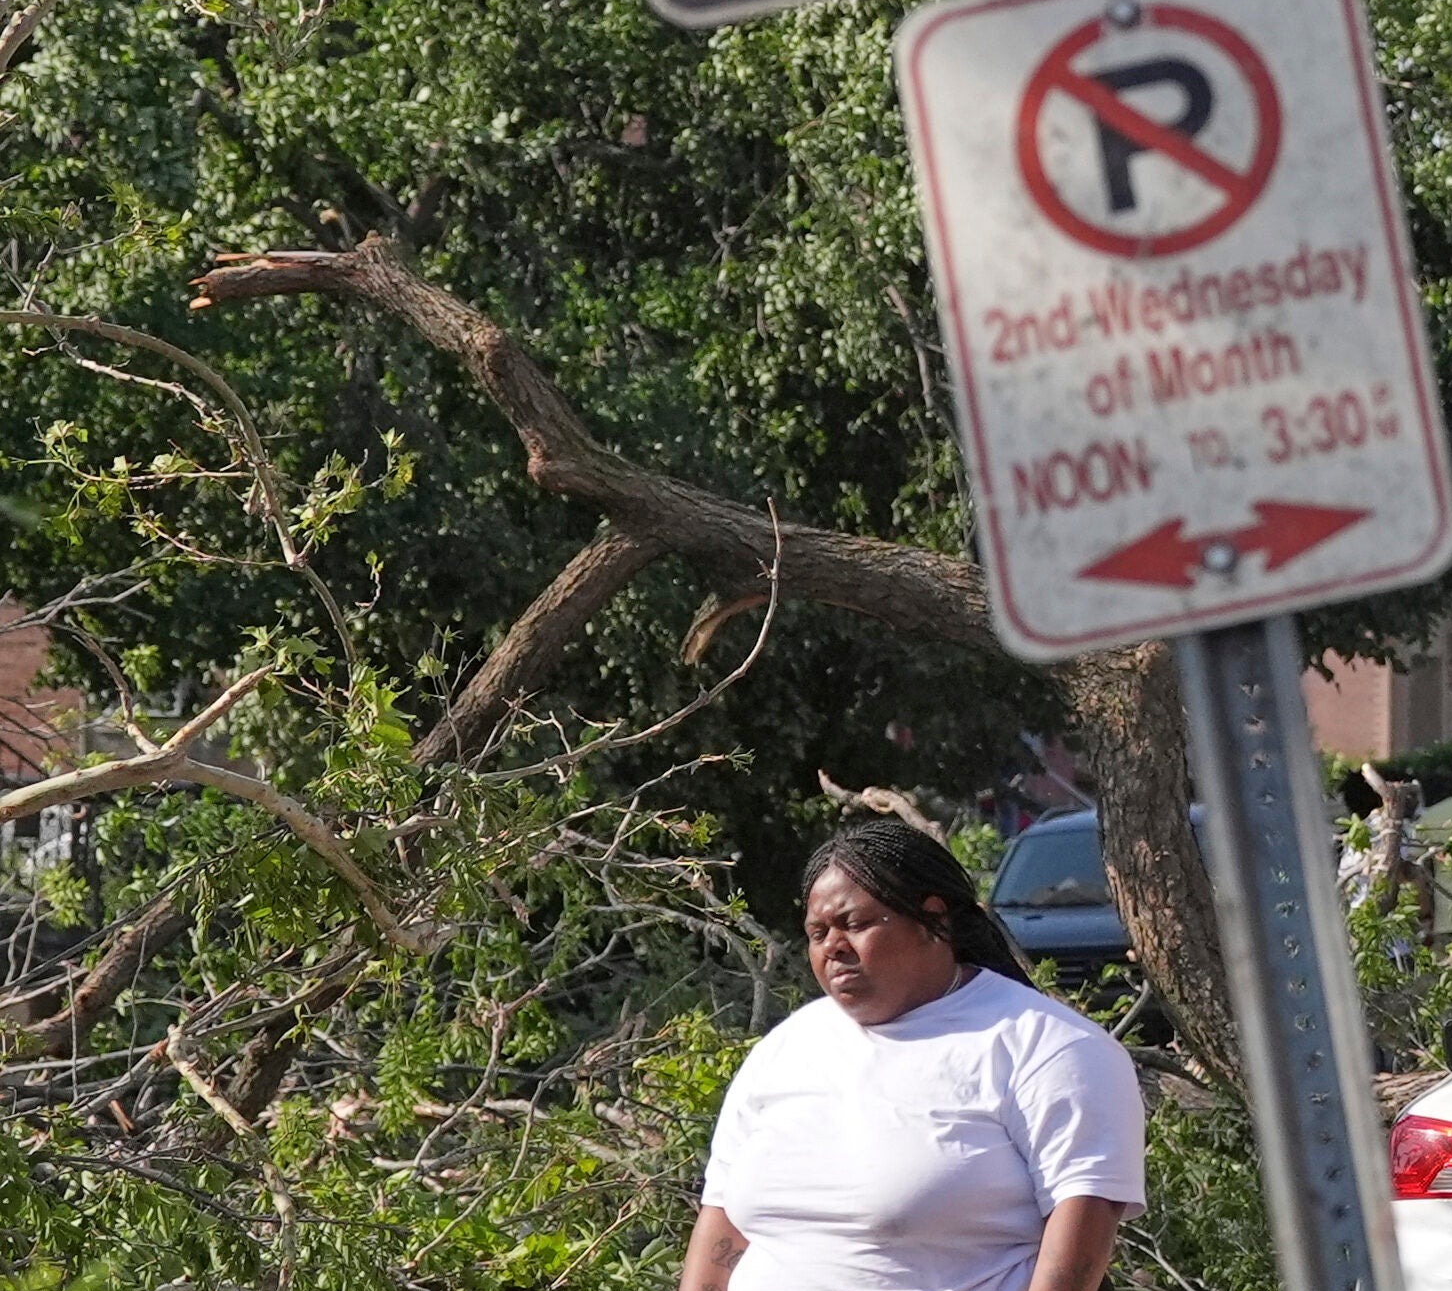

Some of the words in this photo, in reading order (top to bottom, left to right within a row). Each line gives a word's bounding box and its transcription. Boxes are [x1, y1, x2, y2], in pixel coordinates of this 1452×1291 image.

[1088, 241, 1370, 339] Wednesday
[1086, 355, 1133, 418] of
[1146, 326, 1303, 405] Month
[1011, 436, 1154, 517] NOON
[1260, 388, 1369, 465] 3:30
